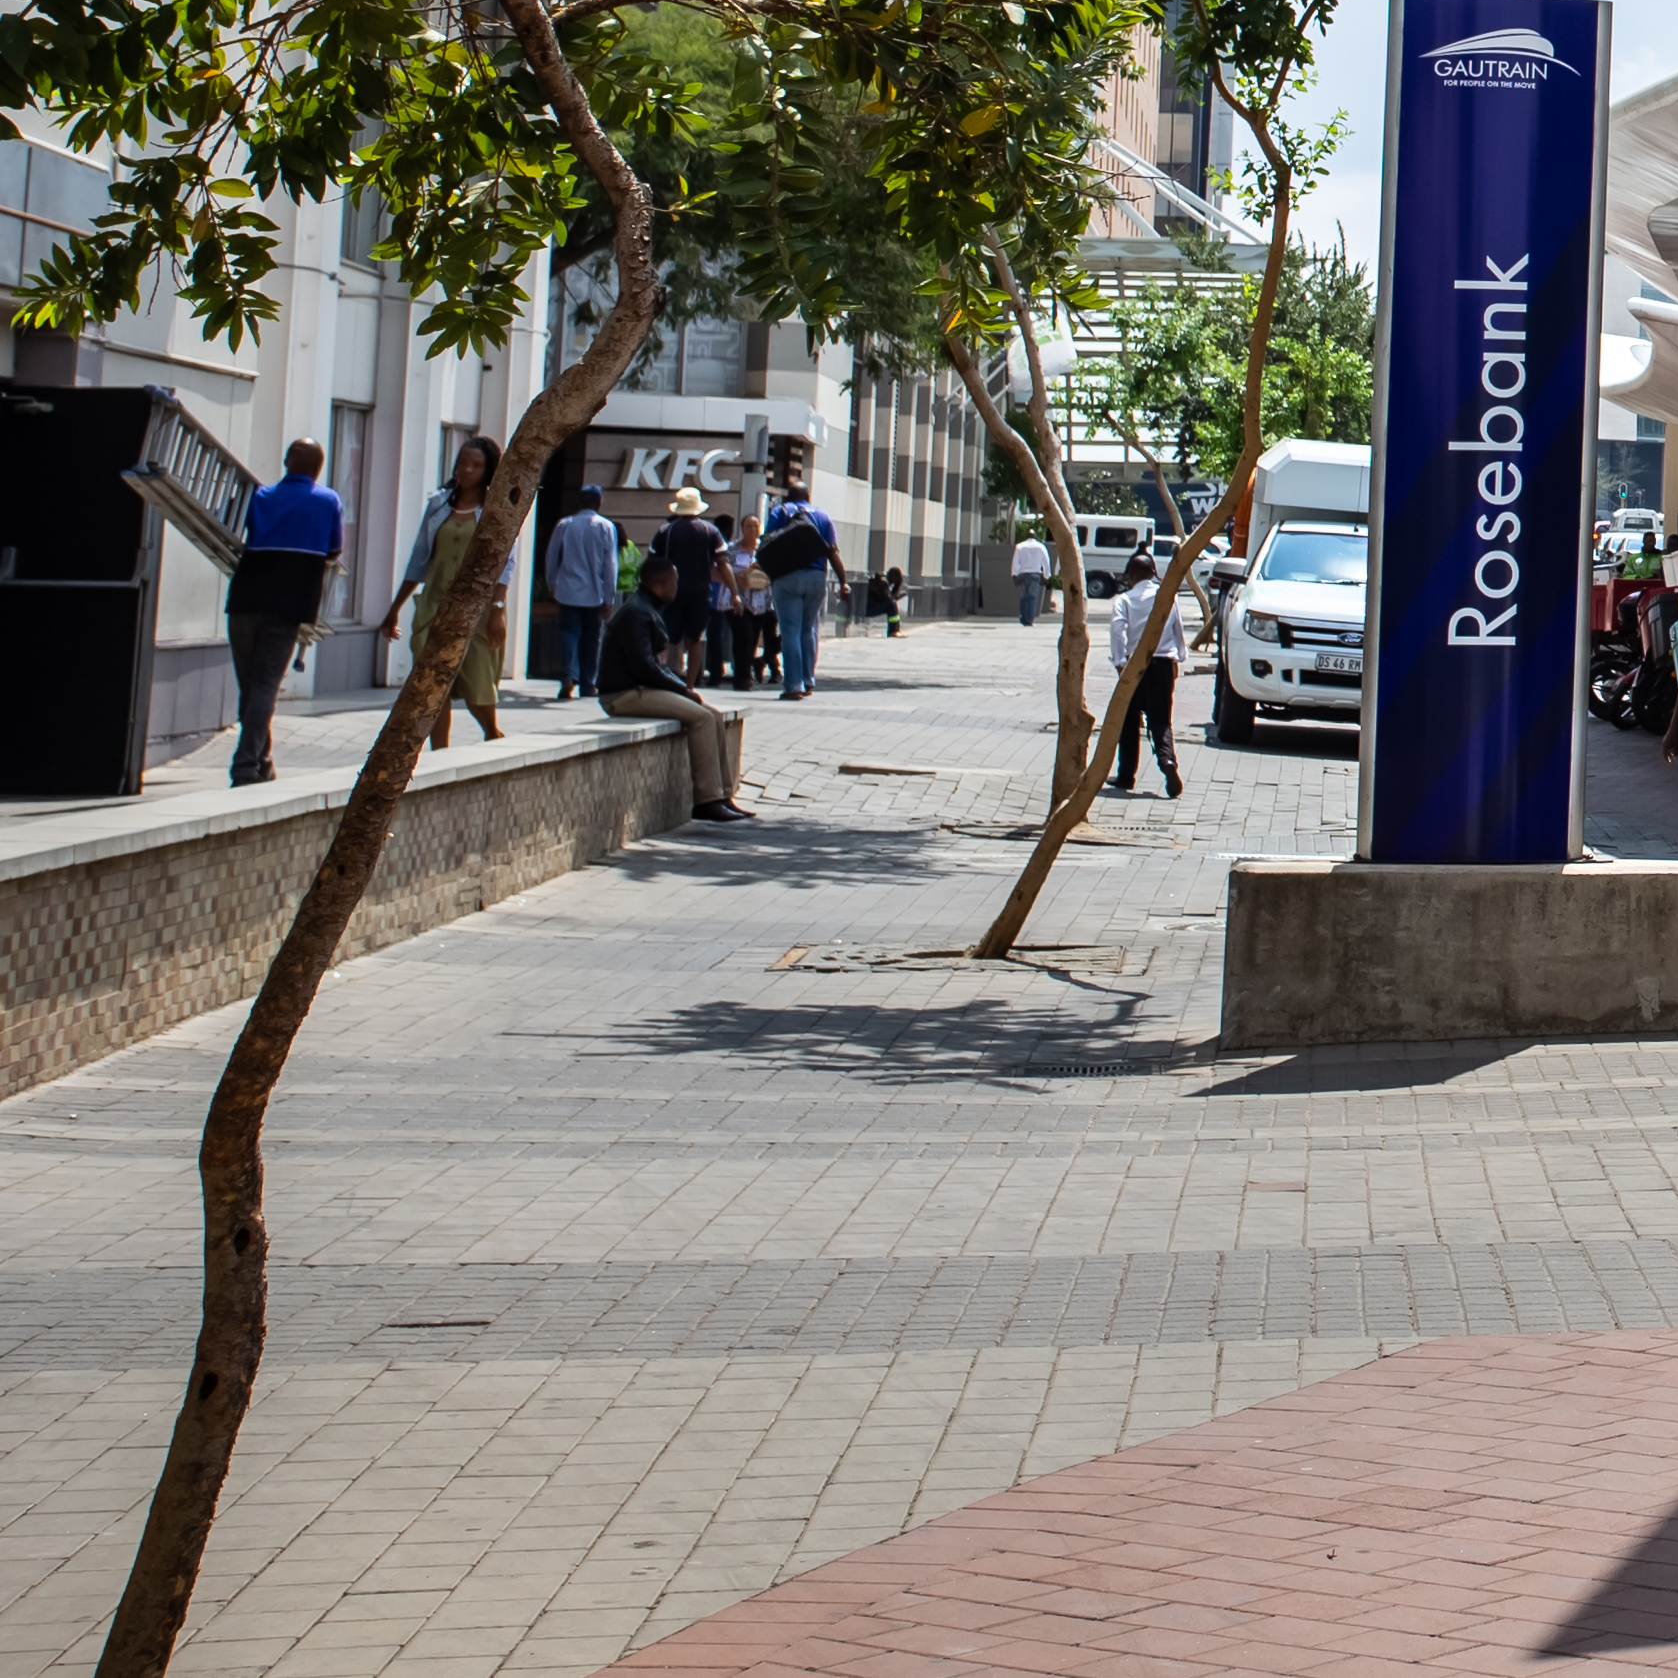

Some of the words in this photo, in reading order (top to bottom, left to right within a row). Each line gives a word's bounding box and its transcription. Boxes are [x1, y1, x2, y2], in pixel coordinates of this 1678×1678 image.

[1434, 59, 1548, 80] GAUTRAIN
[1443, 79, 1459, 87] FOR
[1459, 79, 1486, 88] PEOPLE
[1486, 80, 1499, 88] ON
[1500, 81, 1513, 89] THE
[1514, 81, 1537, 90] MOVE
[1447, 253, 1530, 646] Rosebank
[622, 448, 741, 492] KFC
[1333, 658, 1345, 669] 46
